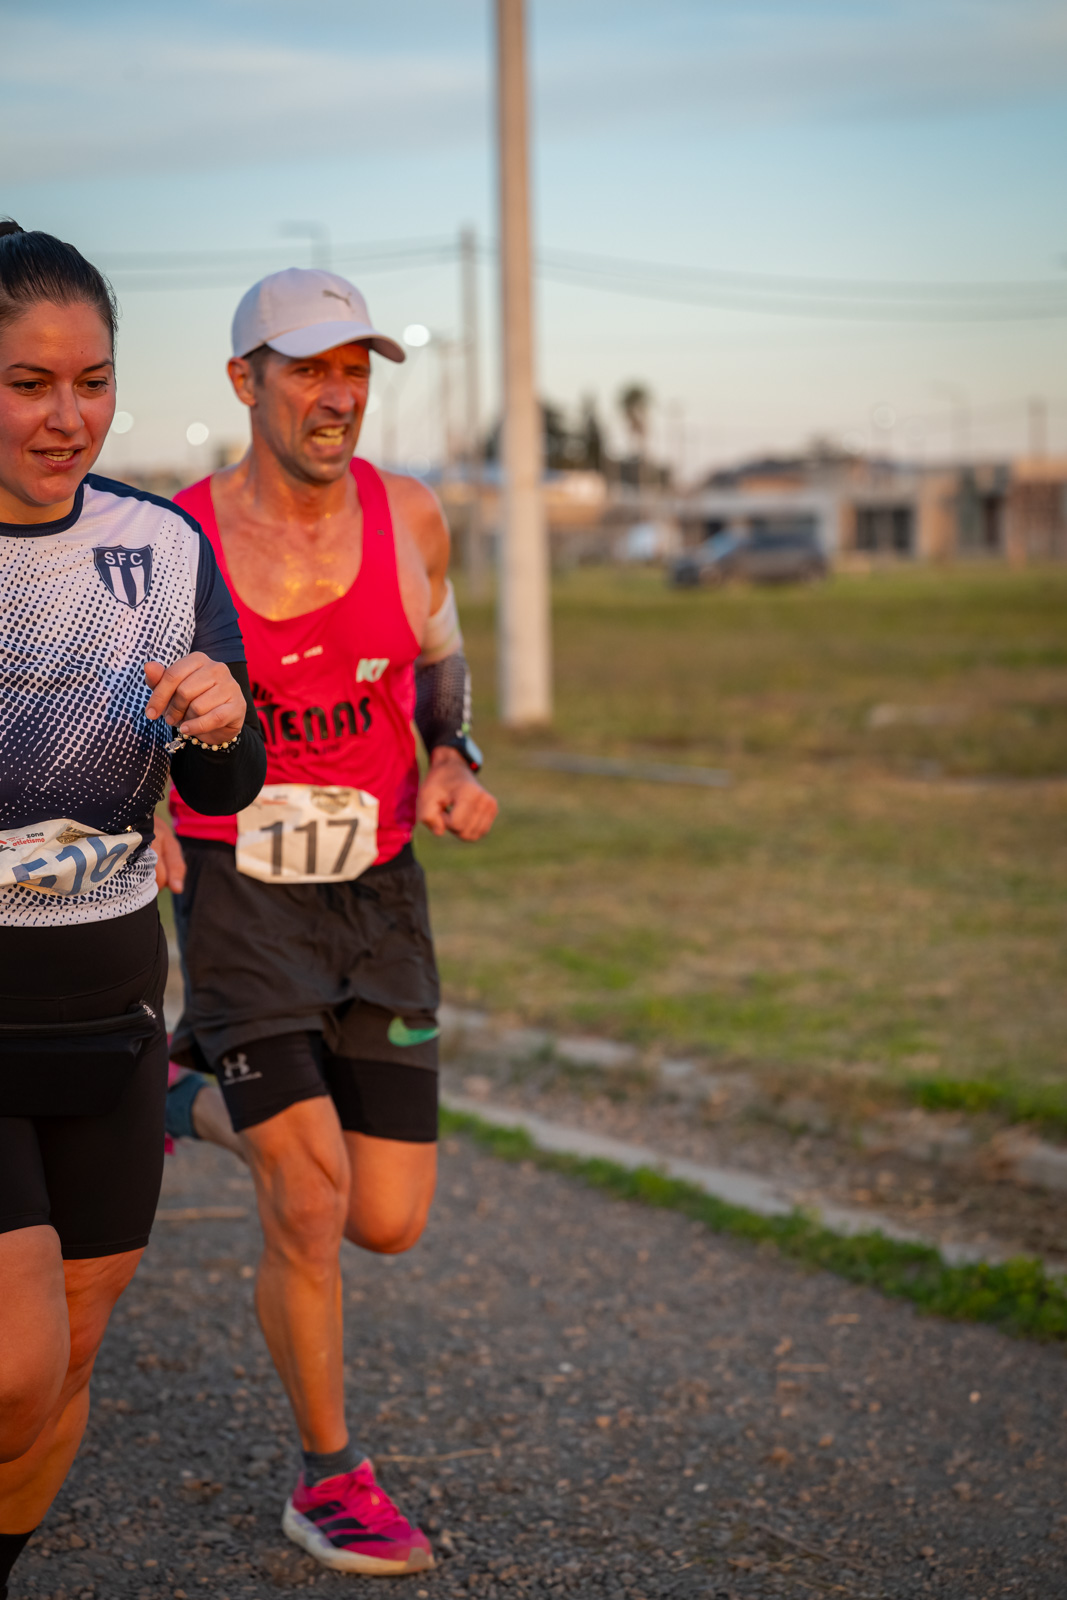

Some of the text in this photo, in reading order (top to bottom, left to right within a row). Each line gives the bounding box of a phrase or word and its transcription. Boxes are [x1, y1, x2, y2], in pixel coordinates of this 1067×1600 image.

[104, 551, 143, 566] SFC
[255, 697, 371, 746] TENAS
[12, 838, 46, 847] atletismo
[260, 818, 359, 877] 117
